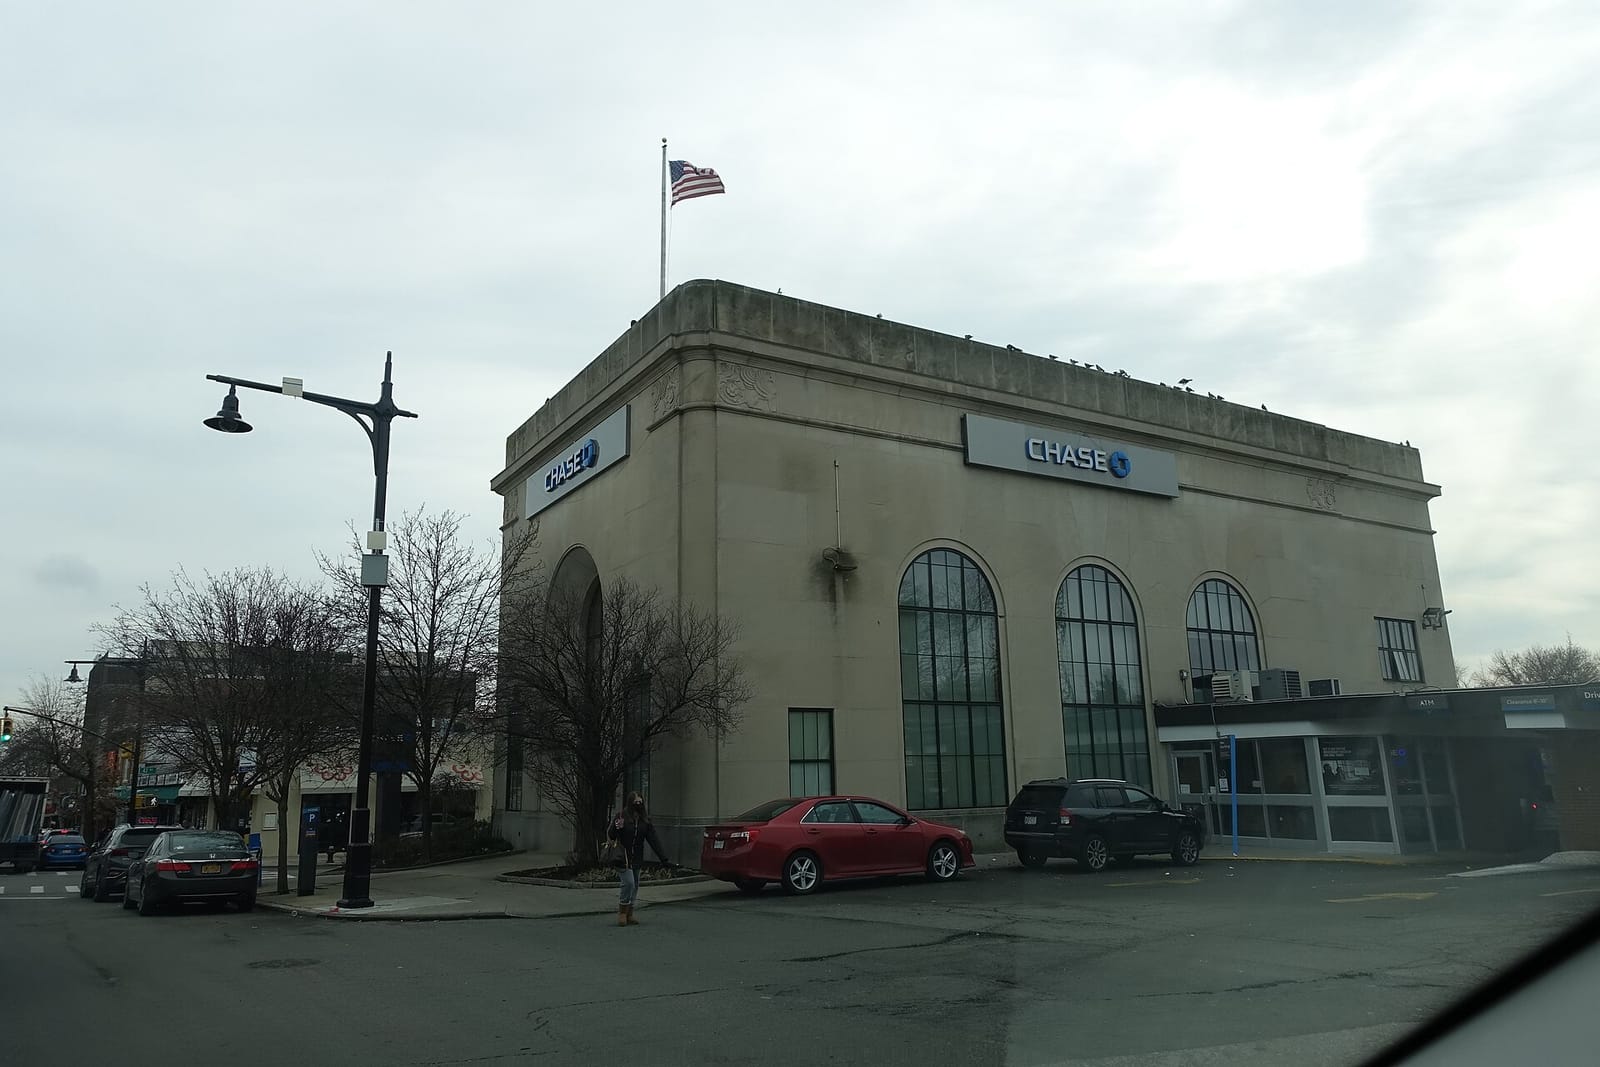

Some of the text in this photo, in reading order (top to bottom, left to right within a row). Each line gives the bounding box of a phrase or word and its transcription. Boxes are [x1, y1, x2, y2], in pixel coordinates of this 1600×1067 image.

[545, 449, 582, 492] CHASE
[1026, 438, 1108, 472] CHASE
[309, 813, 316, 823] P
